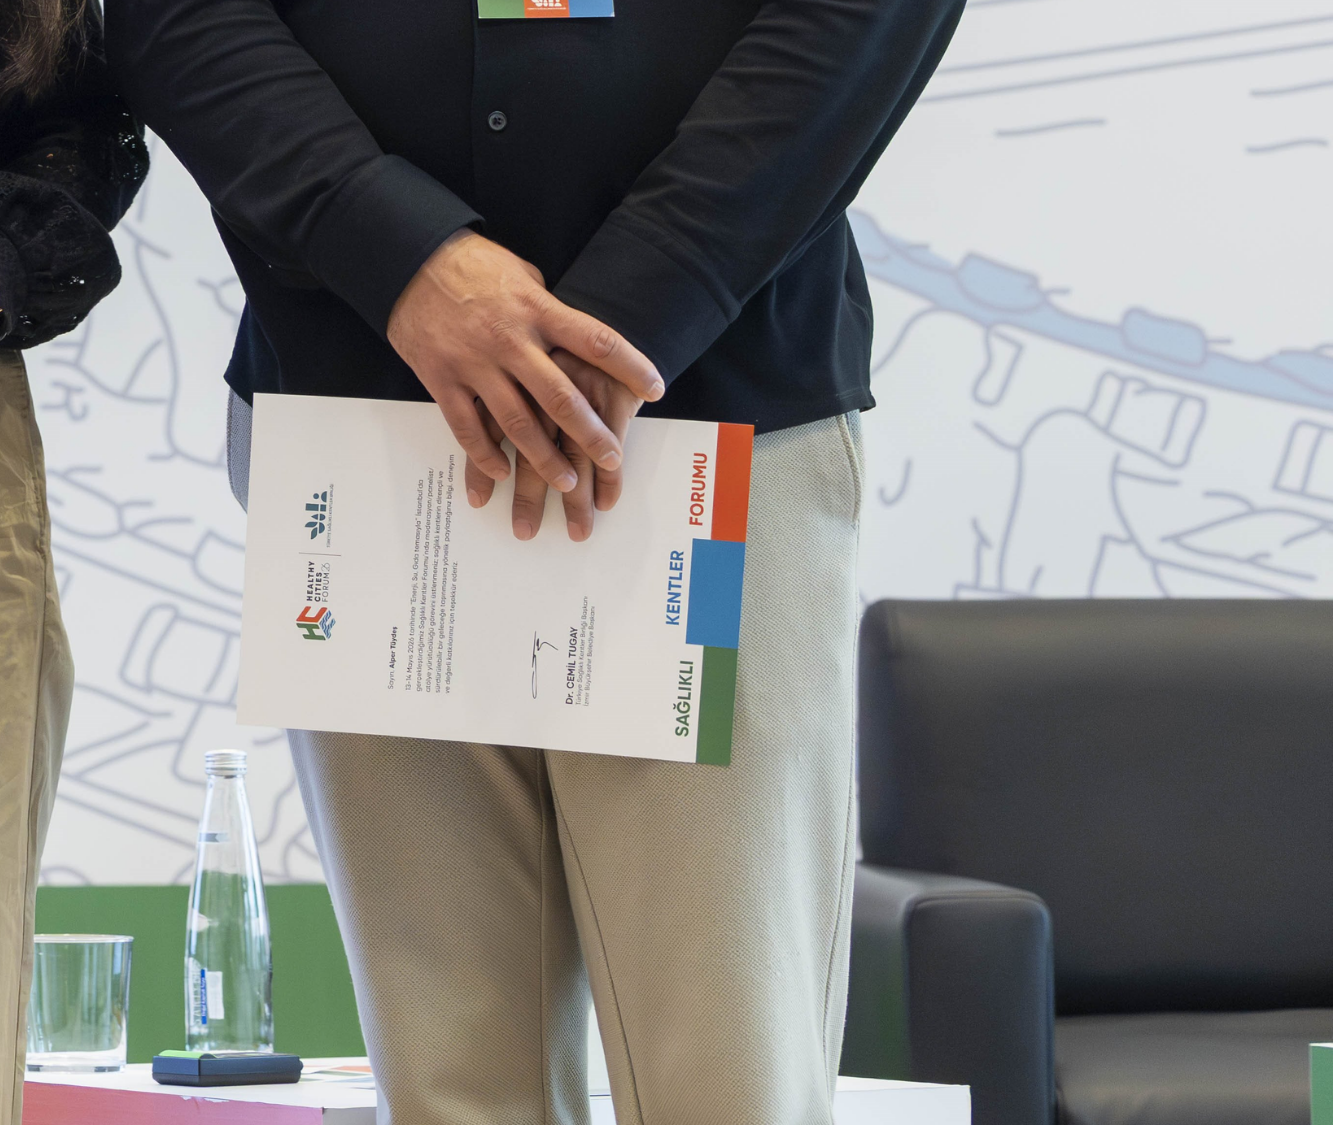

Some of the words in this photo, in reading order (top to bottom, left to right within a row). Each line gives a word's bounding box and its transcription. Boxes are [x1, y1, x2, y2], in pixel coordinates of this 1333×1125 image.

[688, 452, 708, 526] FORUMU
[438, 609, 446, 639] geleceğe
[447, 454, 455, 482] deneyim
[306, 561, 314, 601] HEALTHY
[314, 572, 322, 602] CITIES
[665, 550, 684, 626] KENTLER
[445, 662, 453, 685] değerli
[449, 584, 457, 611] teşekkür
[568, 627, 578, 658] TUGAY
[565, 692, 574, 705] Dr.
[566, 661, 576, 689] CEMİL
[673, 660, 694, 737] SAĞLIKLI
